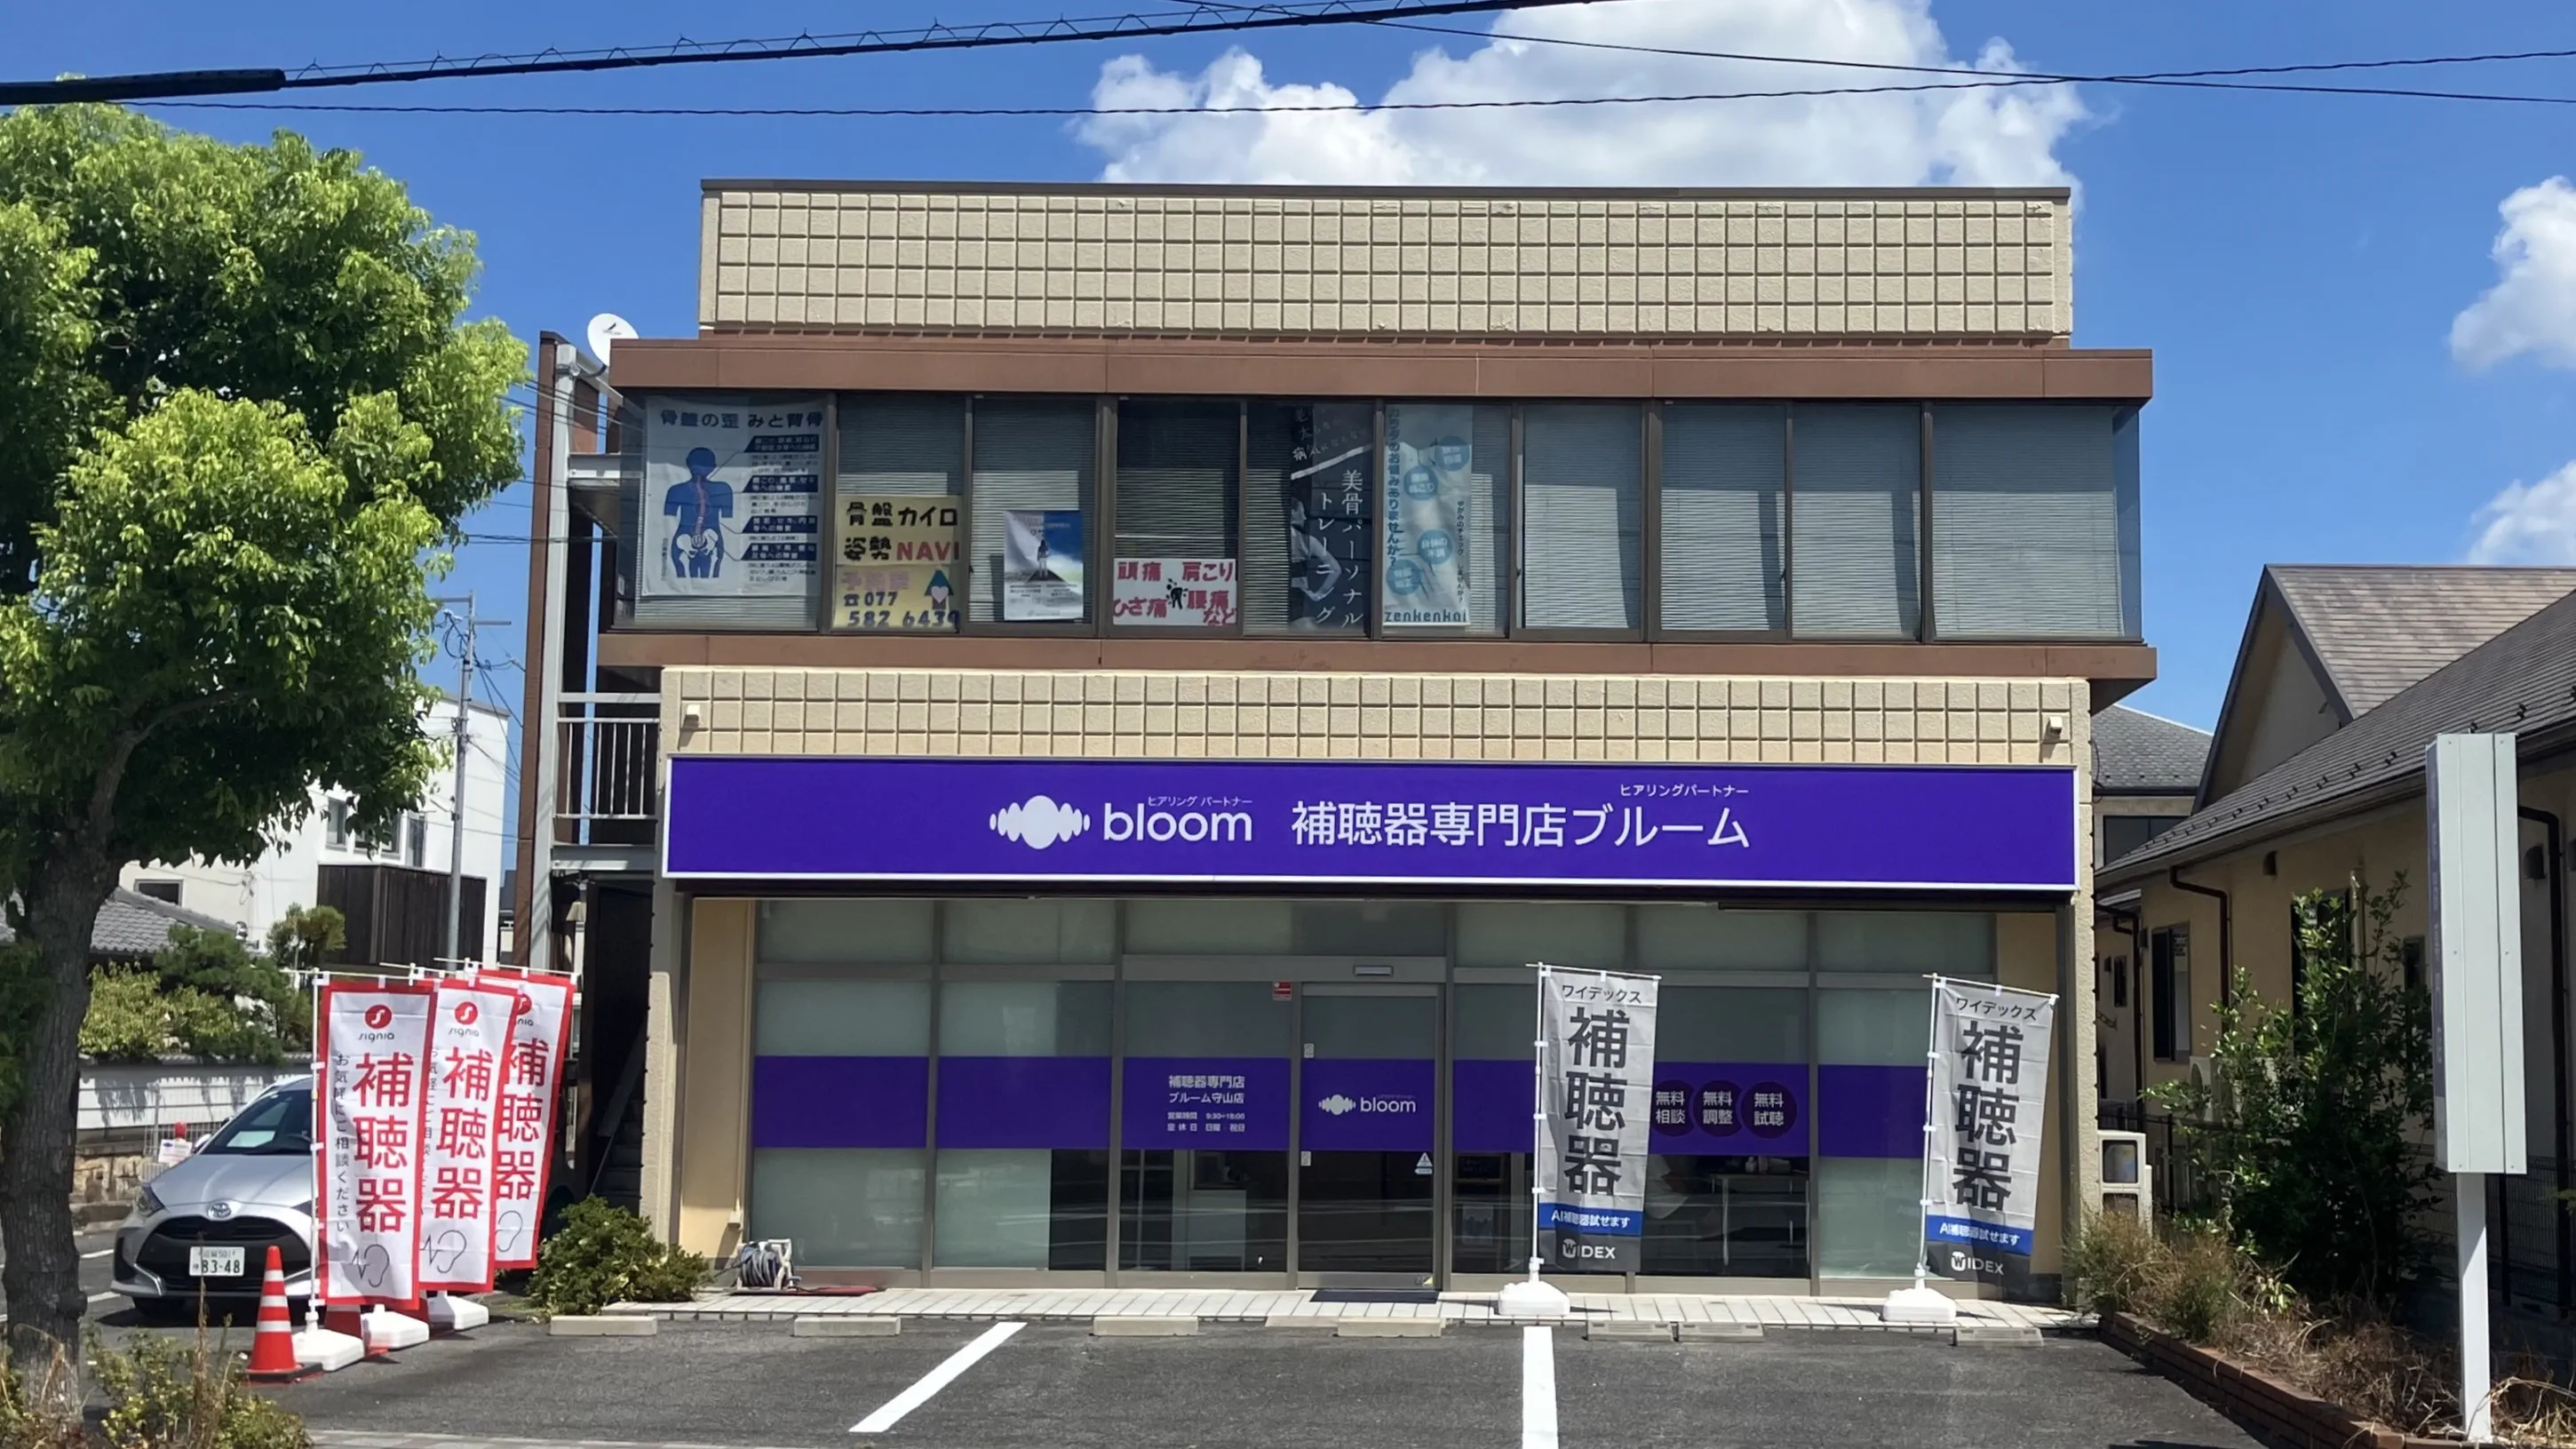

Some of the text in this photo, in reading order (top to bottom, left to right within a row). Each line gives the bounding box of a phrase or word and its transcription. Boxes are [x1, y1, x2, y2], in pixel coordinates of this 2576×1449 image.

[847, 502, 958, 527] 骨盤カイロ
[1316, 492, 1336, 624] トレーニング
[1341, 469, 1364, 628] 美骨パーソナル
[1117, 561, 1234, 582] 頭痛 肩こり
[864, 592, 898, 607] 077
[1113, 597, 1168, 618] ひざ痛
[1187, 590, 1229, 609] 腰痛
[848, 610, 891, 627] 582
[1385, 609, 1467, 623] zenkenkai
[1619, 784, 1749, 797] ヒアリングパートナー
[1103, 802, 1252, 841] bloom
[1291, 800, 1750, 848] 補聴器専門店ブルーム
[1562, 984, 1642, 1005] ワイデックス
[1956, 997, 2037, 1021] ワイデックス
[359, 1031, 394, 1042] signia
[448, 1026, 480, 1038] signia
[1169, 1075, 1245, 1088] 補聴器専門店
[1169, 1092, 1244, 1103] ブルーム守山店
[1360, 1096, 1417, 1112] bloom
[1564, 1007, 1631, 1196] 補聴器
[1656, 1091, 1685, 1106] 無料
[1703, 1091, 1732, 1106] 無料
[1754, 1093, 1784, 1108] 無料
[497, 1038, 549, 1200] 補聴器
[1656, 1109, 1685, 1124] 相談
[1703, 1110, 1733, 1125] 調整
[1753, 1111, 1785, 1127] 試聴
[1952, 1021, 2023, 1212] 補聴器
[334, 1055, 350, 1232] お気軽にご相談ください
[352, 1052, 414, 1233] 補聴器
[431, 1047, 493, 1219] 補聴器
[1551, 1209, 1631, 1229] AI補聴器試せます
[1939, 1222, 2021, 1246] AI補聴器試せます
[1562, 1238, 1616, 1259] WIDEX
[1951, 1251, 2005, 1275] WIDEX
